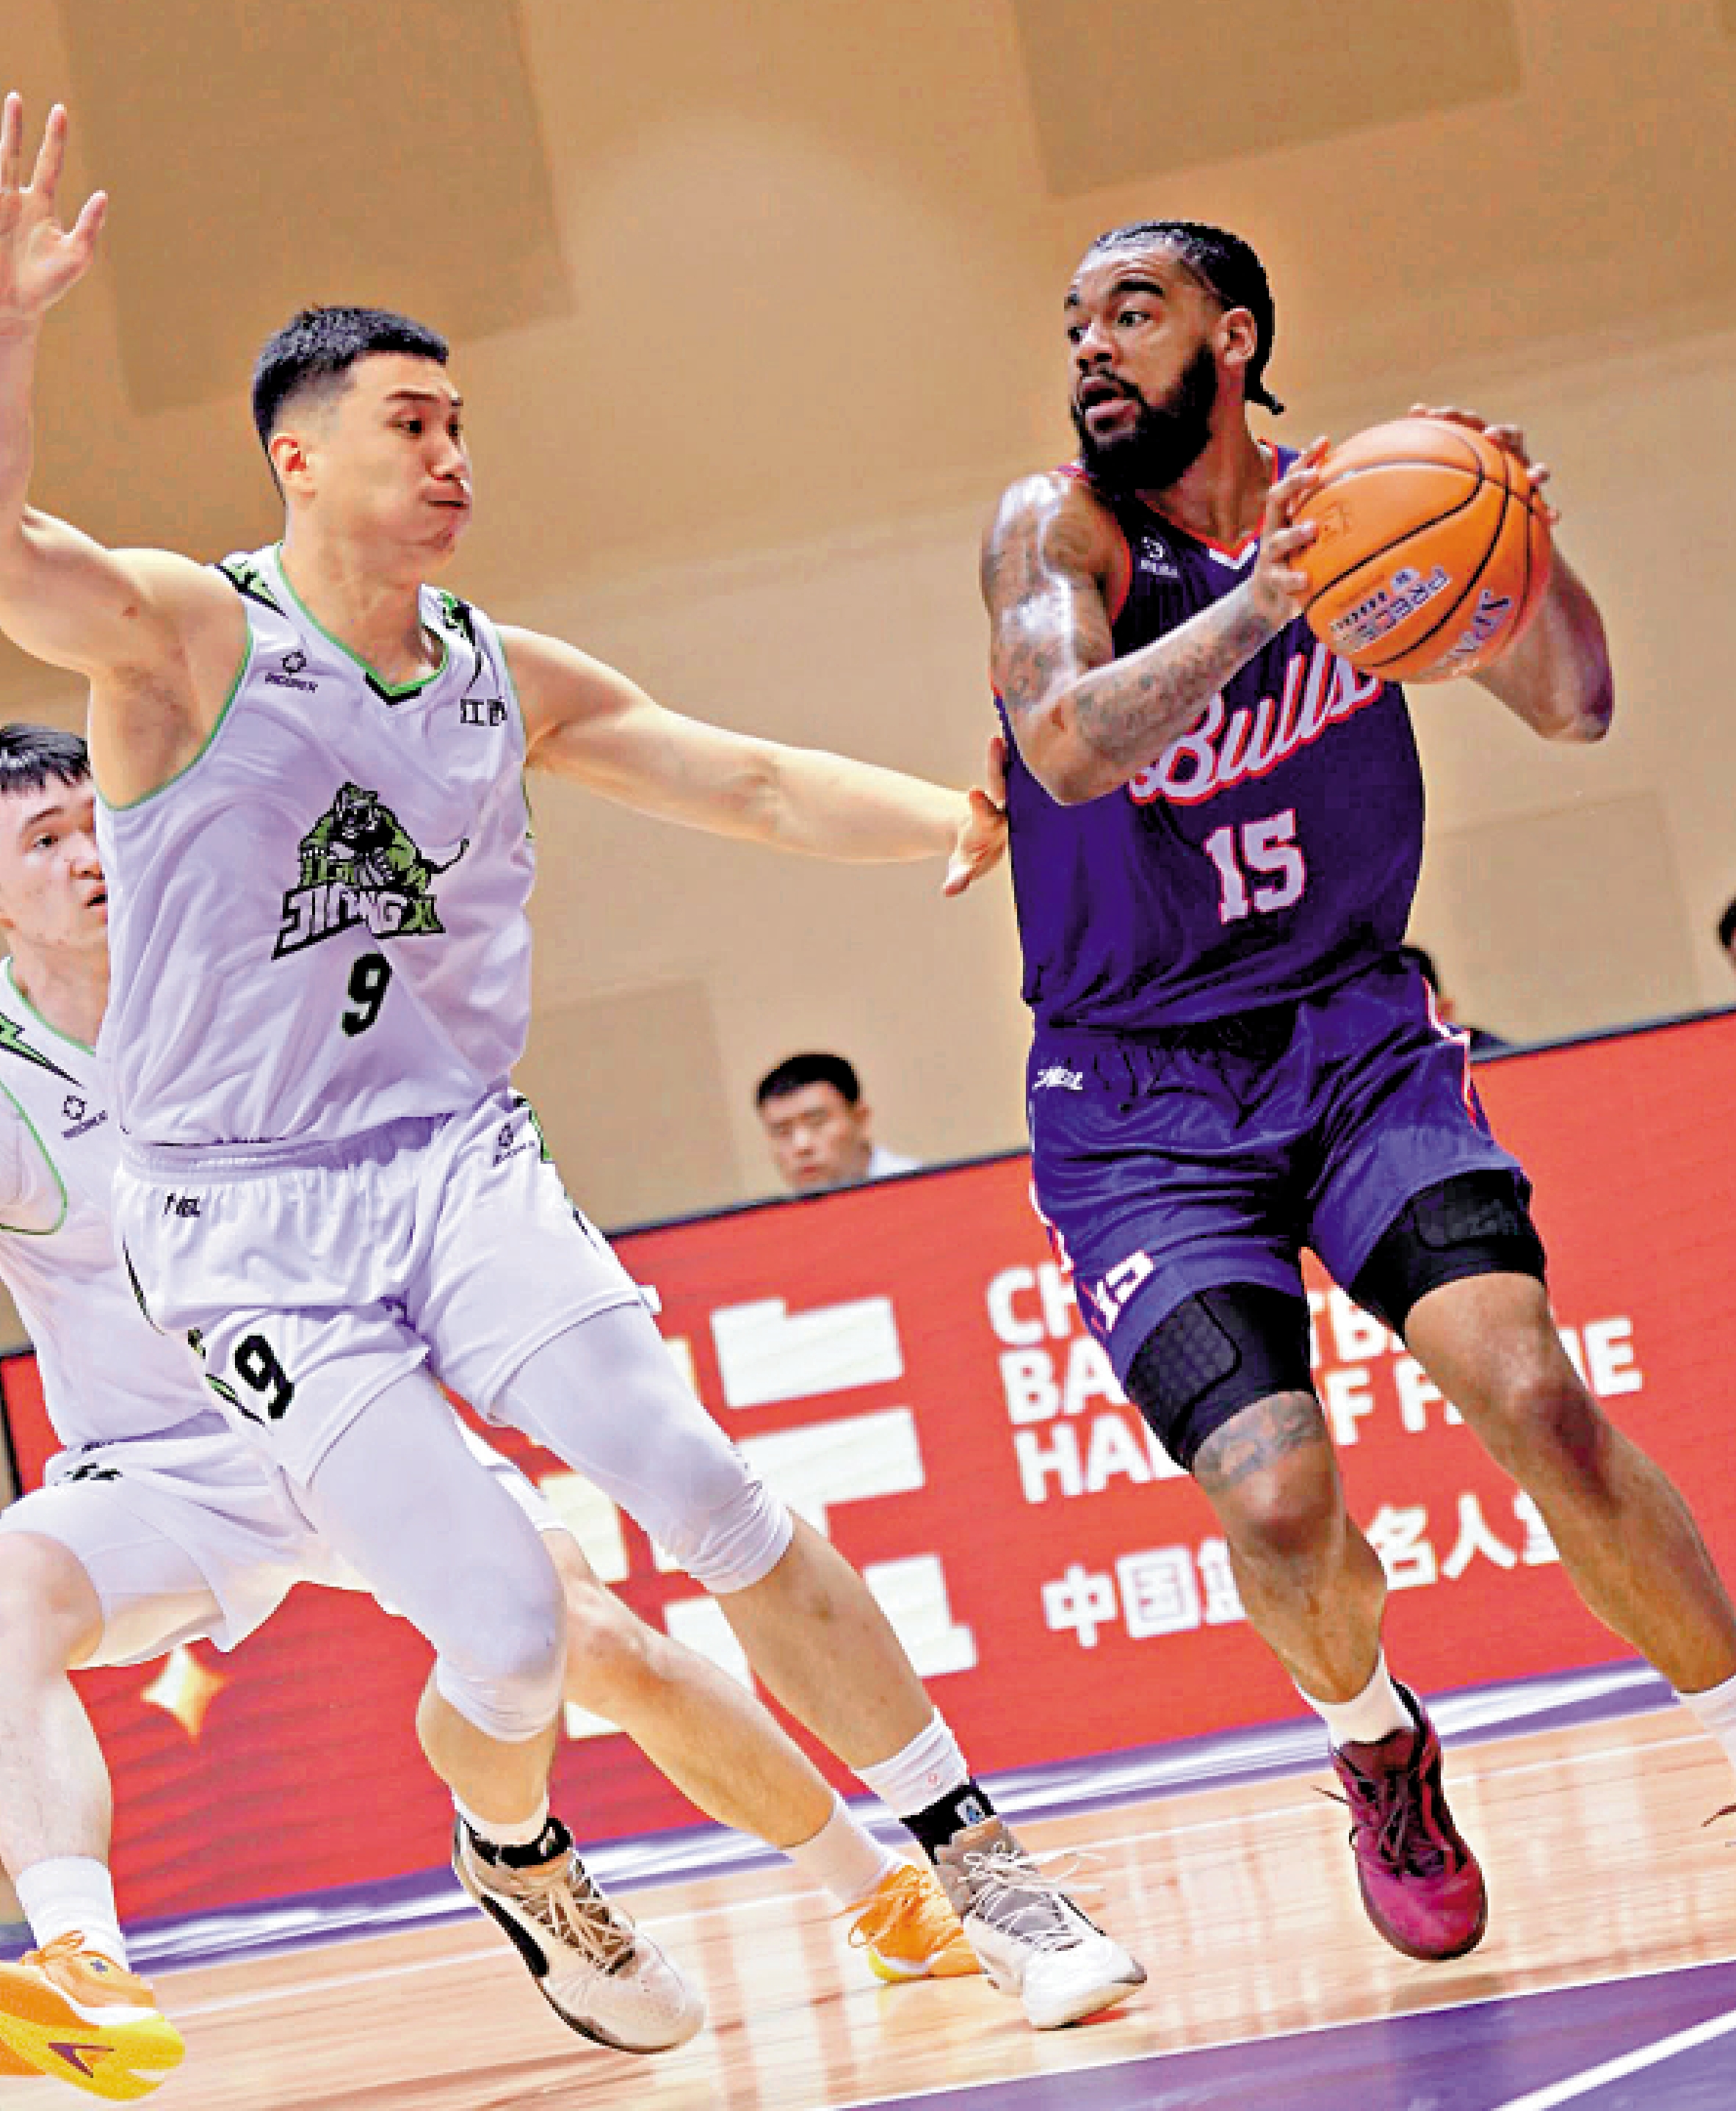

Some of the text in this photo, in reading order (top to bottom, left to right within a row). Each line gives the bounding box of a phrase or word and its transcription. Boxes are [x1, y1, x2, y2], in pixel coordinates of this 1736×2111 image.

[1129, 640, 1385, 805] Bulls
[1204, 808, 1306, 924] 15
[341, 952, 393, 1038] 9
[234, 1334, 294, 1419] 9
[1013, 1410, 1193, 1505] HAL
